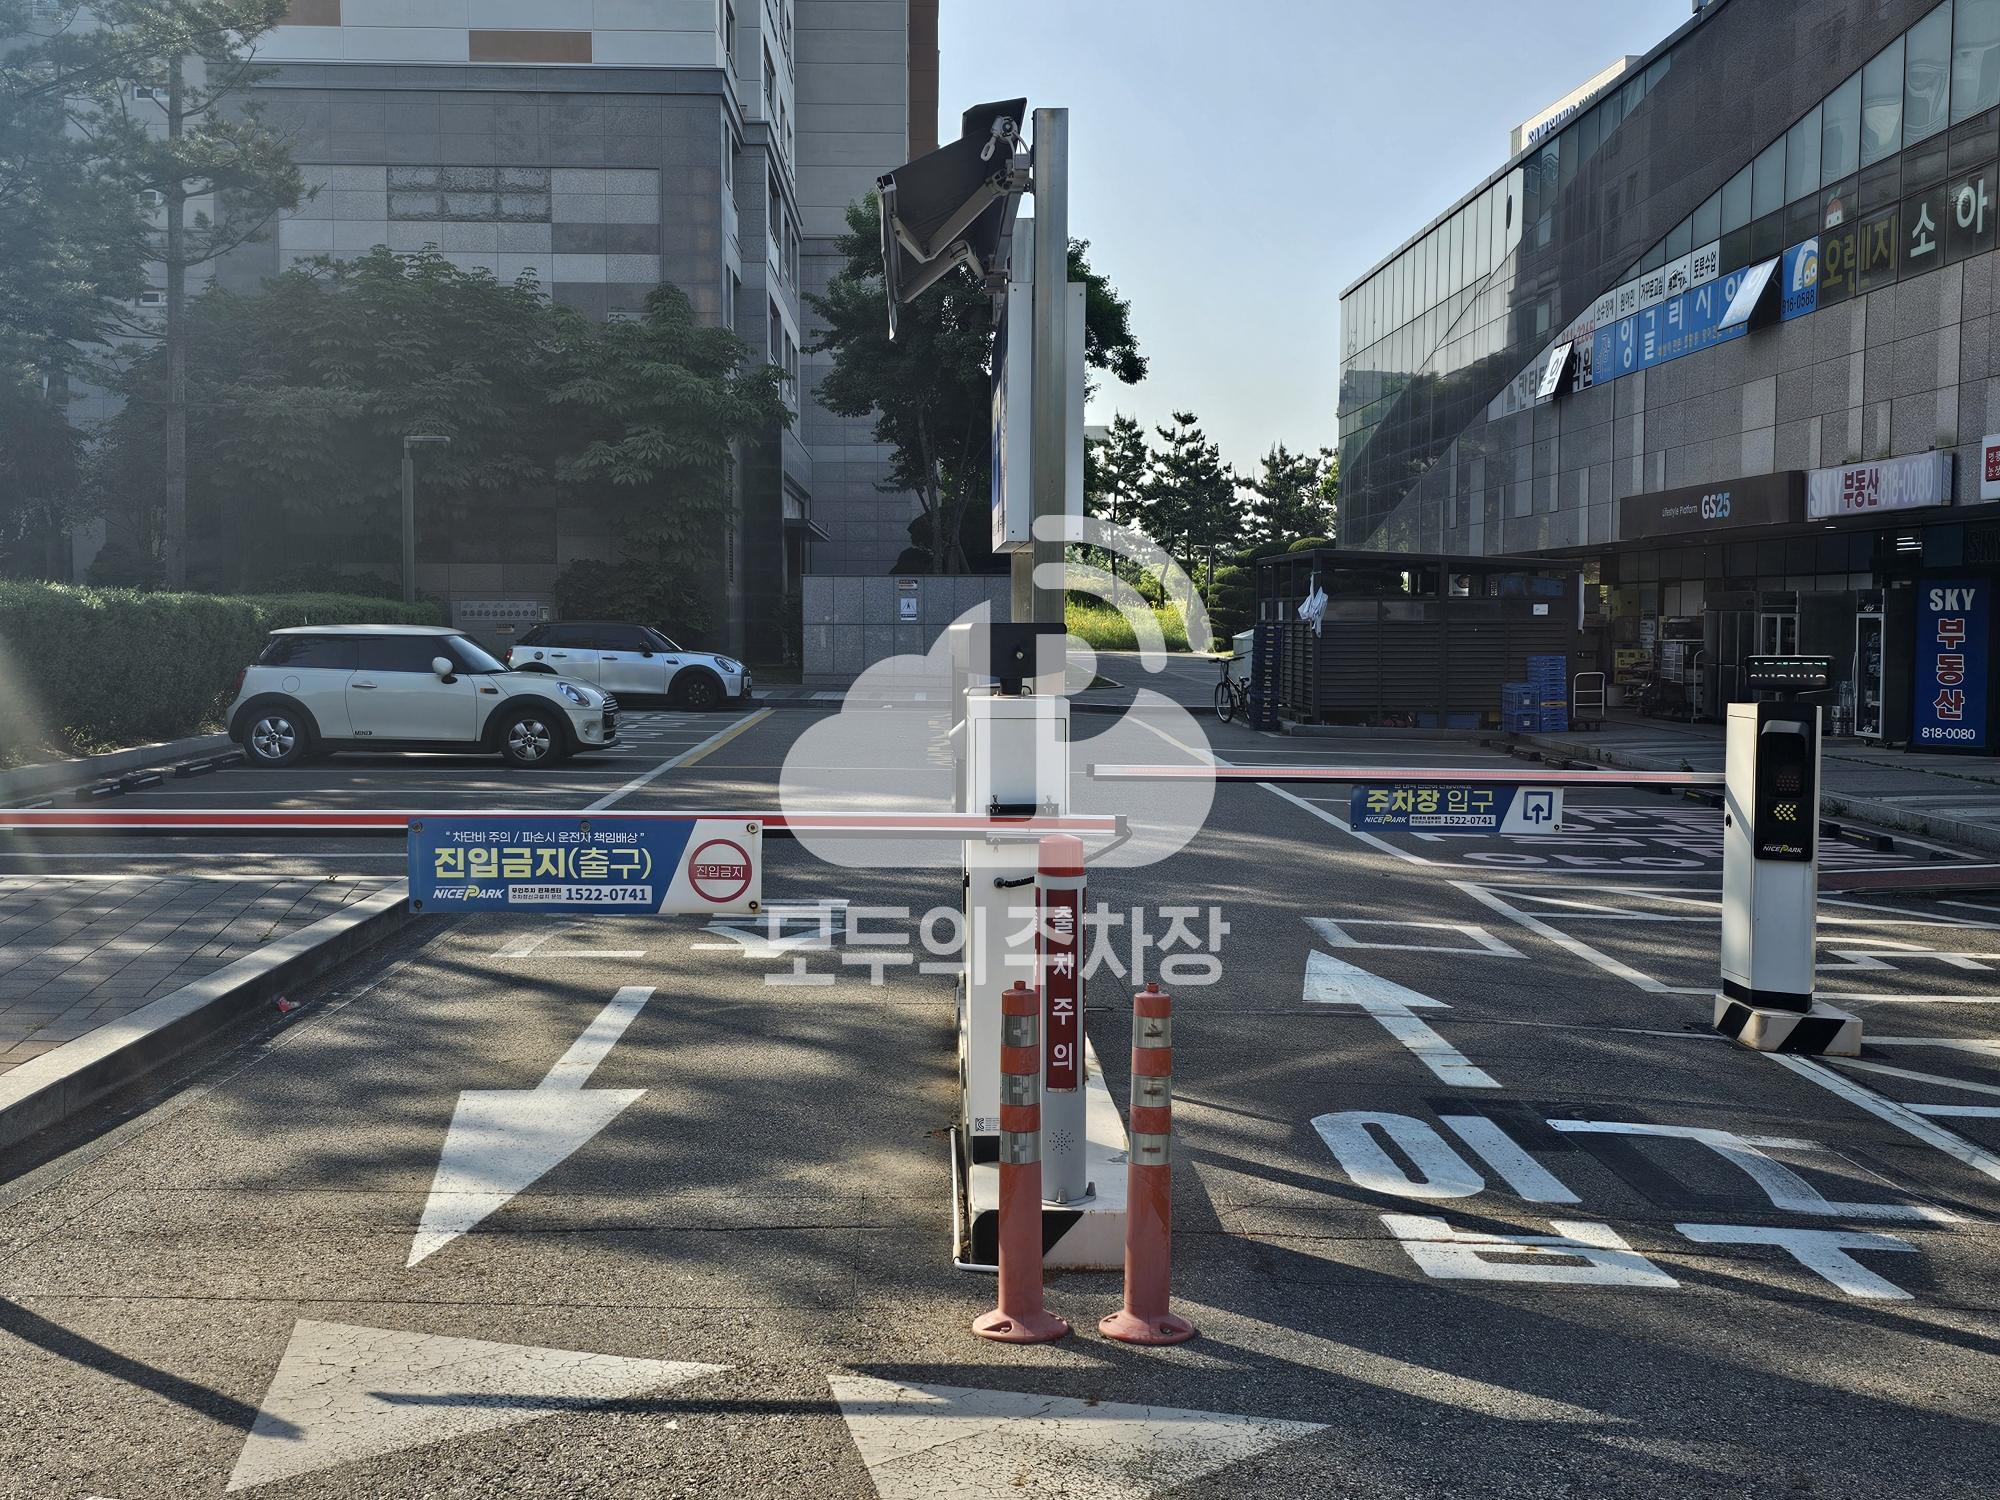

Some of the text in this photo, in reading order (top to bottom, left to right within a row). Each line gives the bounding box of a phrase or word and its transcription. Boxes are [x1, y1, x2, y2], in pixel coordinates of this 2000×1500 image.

[1822, 178, 1989, 297] 오렌지 소아
[1809, 462, 1934, 516] SKY 부동산 818-0080
[1701, 492, 1731, 520] GS25
[1929, 588, 1976, 612] SKY
[1932, 617, 1966, 721] 부동산
[1921, 727, 1977, 741] 818-0080
[1366, 789, 1495, 814] 주차장 입구
[1443, 816, 1494, 826] 1522-0741
[452, 831, 487, 844] 차단바
[488, 831, 512, 844] 주의
[522, 831, 556, 844] 파손시
[557, 831, 592, 844] 운전자
[593, 831, 638, 845] 책임배상
[434, 847, 653, 880] 진입금지(출구)
[696, 864, 744, 880] 진입금지
[565, 886, 648, 901] 1522-0741
